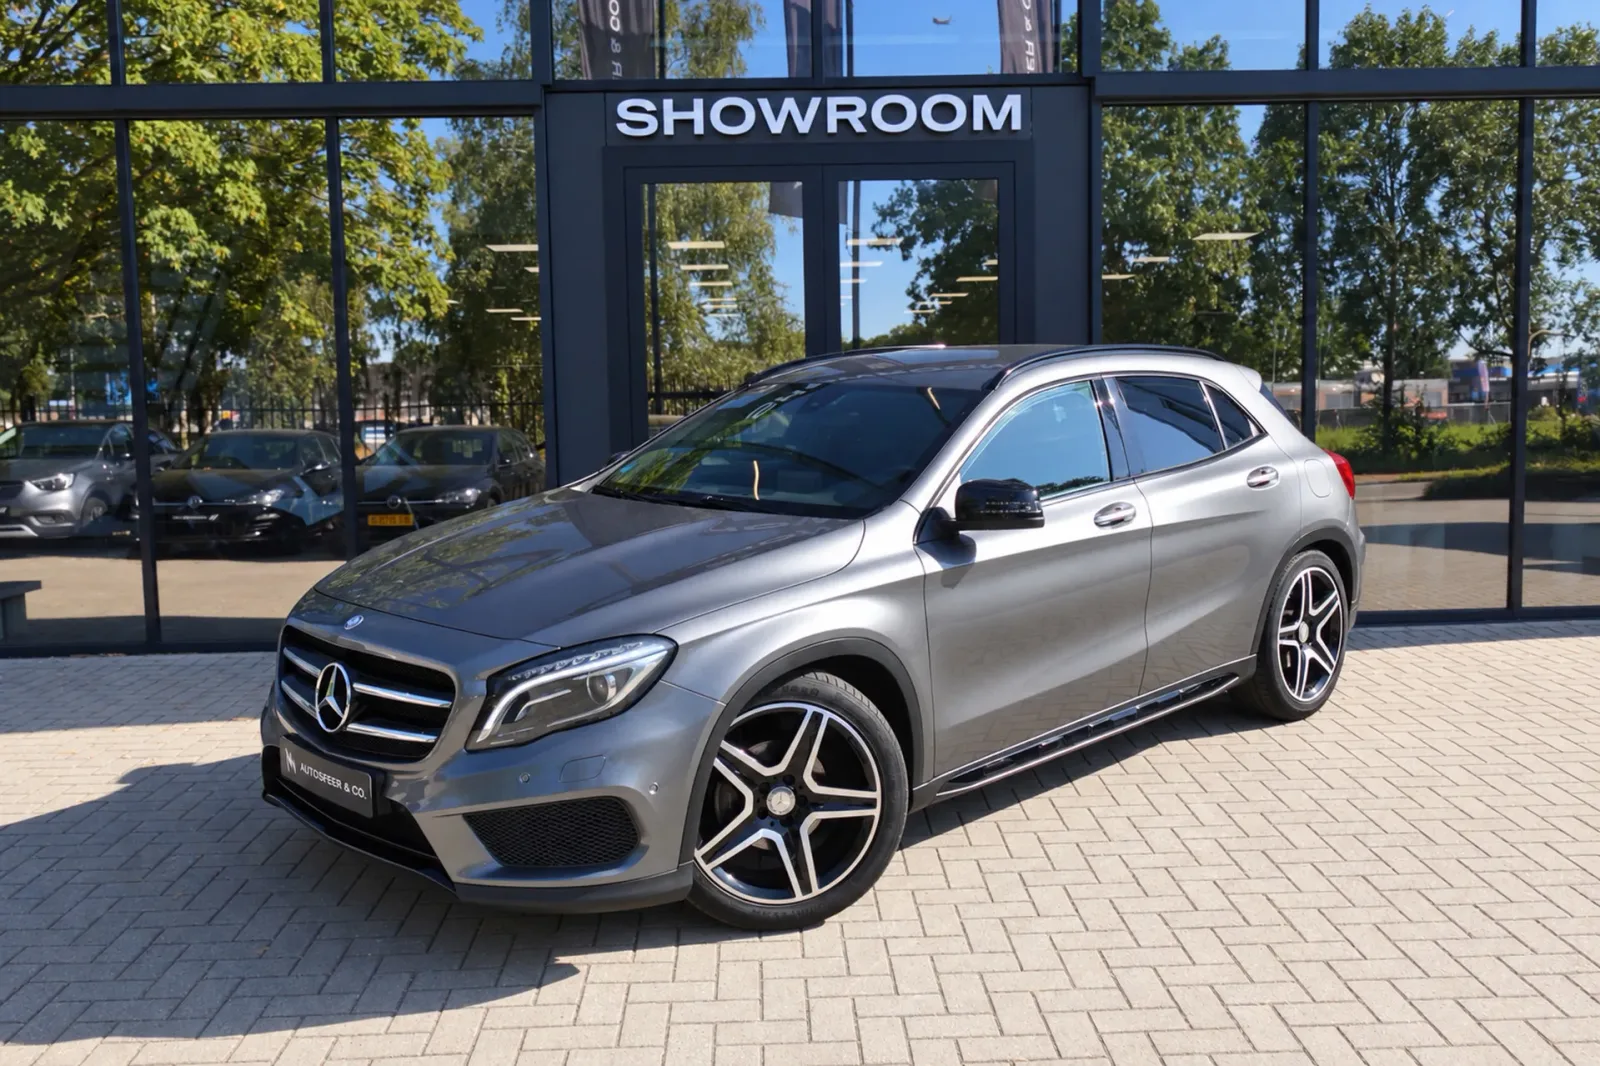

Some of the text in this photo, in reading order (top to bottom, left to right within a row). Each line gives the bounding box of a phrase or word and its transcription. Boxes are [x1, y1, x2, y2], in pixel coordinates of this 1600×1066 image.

[616, 93, 1022, 136] SHOWROOM
[300, 763, 367, 800] AUTOSFEER & CO.
